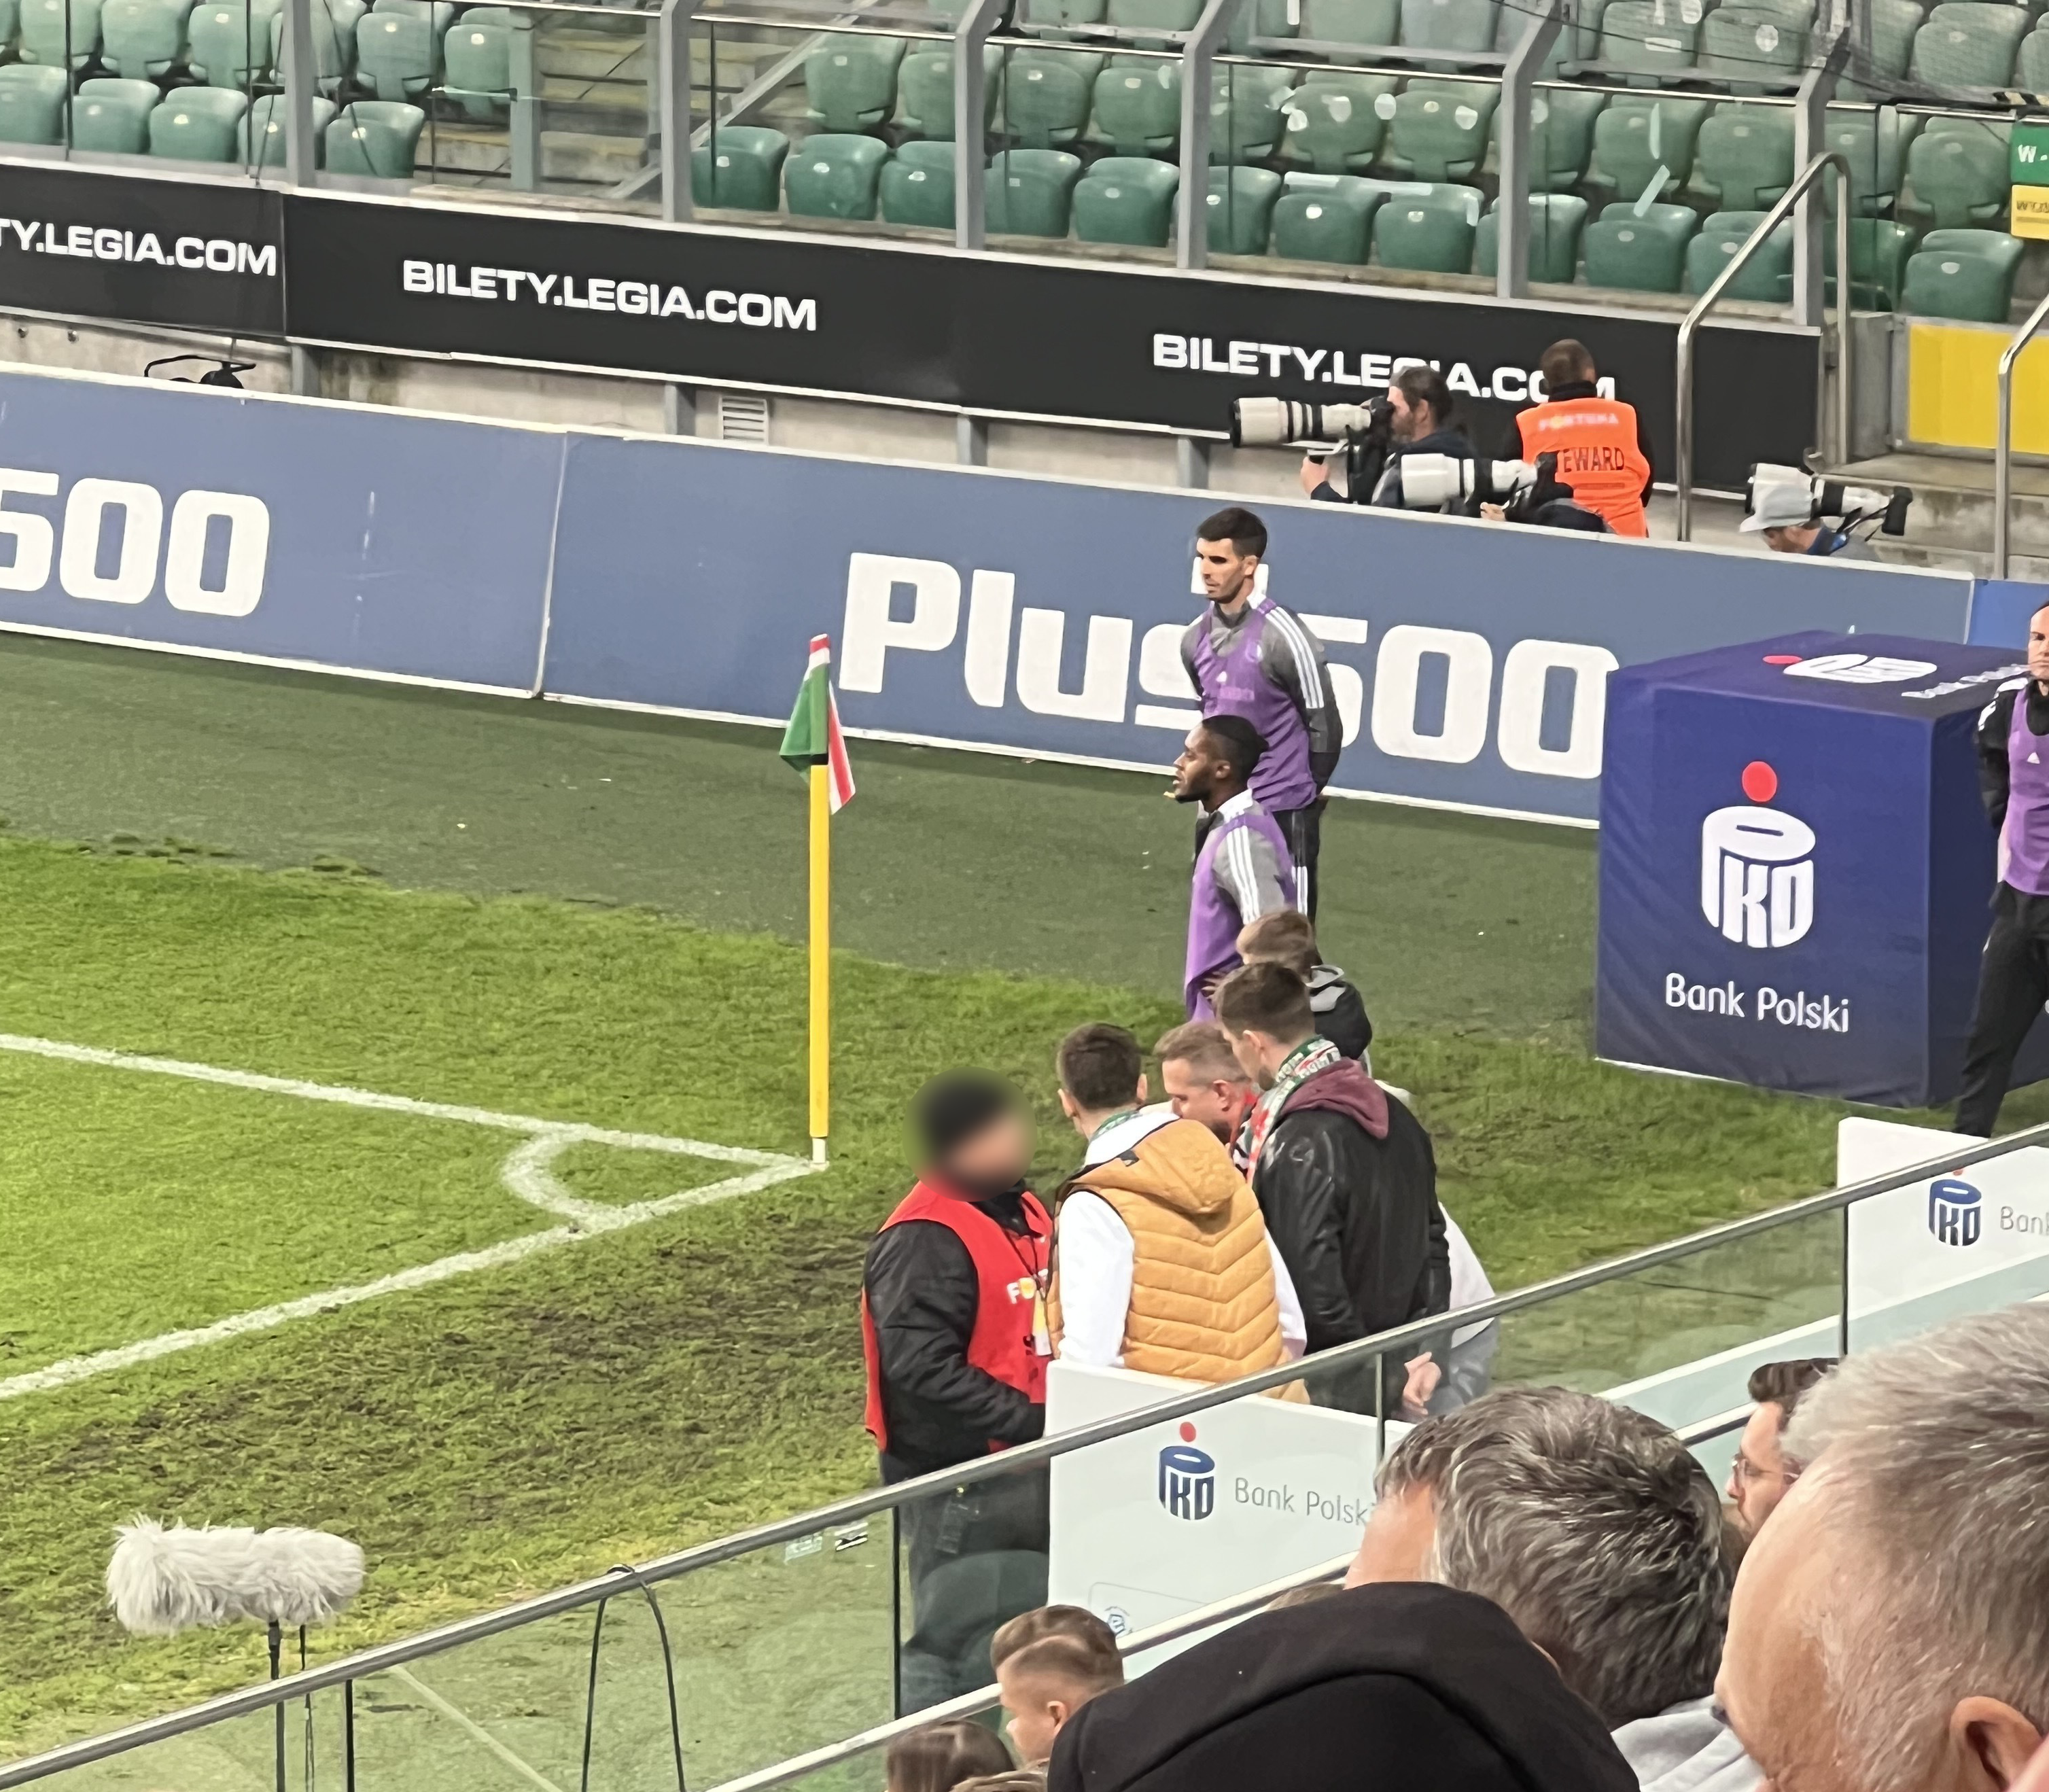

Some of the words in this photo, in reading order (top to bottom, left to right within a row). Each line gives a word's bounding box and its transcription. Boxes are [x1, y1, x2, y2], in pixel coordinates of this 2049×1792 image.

[403, 260, 817, 331] BILETY.LEGIA.COM
[1153, 333, 1615, 403] BILETY.LEA.C
[1561, 446, 1626, 474] EWARD
[1665, 972, 1745, 1018] Bank
[1757, 987, 1849, 1033] Polski
[1235, 1477, 1295, 1513] Bank
[1306, 1491, 1375, 1526] Polsk
